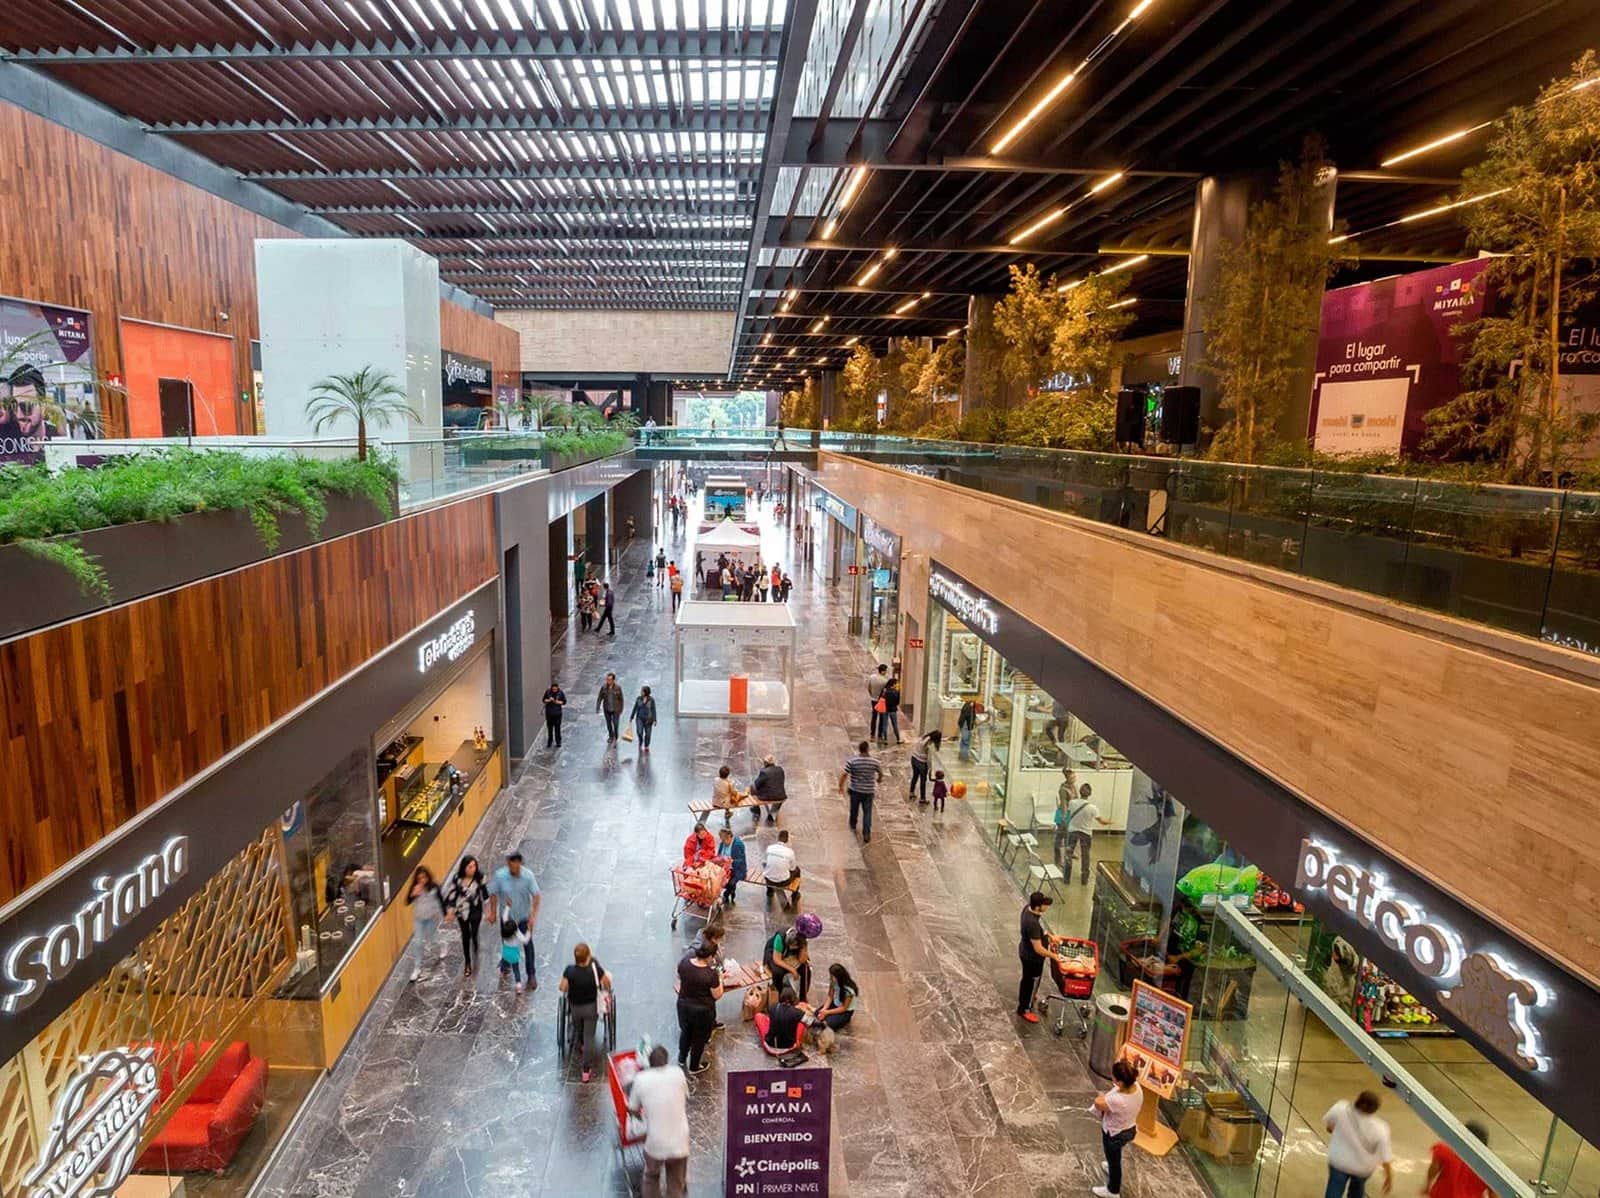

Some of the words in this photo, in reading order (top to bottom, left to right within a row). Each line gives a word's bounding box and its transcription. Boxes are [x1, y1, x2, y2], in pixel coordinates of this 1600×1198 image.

[1569, 328, 1586, 346] El
[1346, 343, 1355, 359] El
[1357, 342, 1386, 361] lugar
[1329, 364, 1351, 377] para
[1353, 355, 1401, 375] compartir
[1295, 838, 1456, 977] petco
[746, 1102, 812, 1115] MIYANA
[744, 1132, 812, 1144] BIENVENIDO
[757, 1159, 819, 1173] Cinépolis
[736, 1183, 754, 1194] PN
[763, 1184, 792, 1193] PRIMER
[794, 1183, 819, 1193] NIVEL
